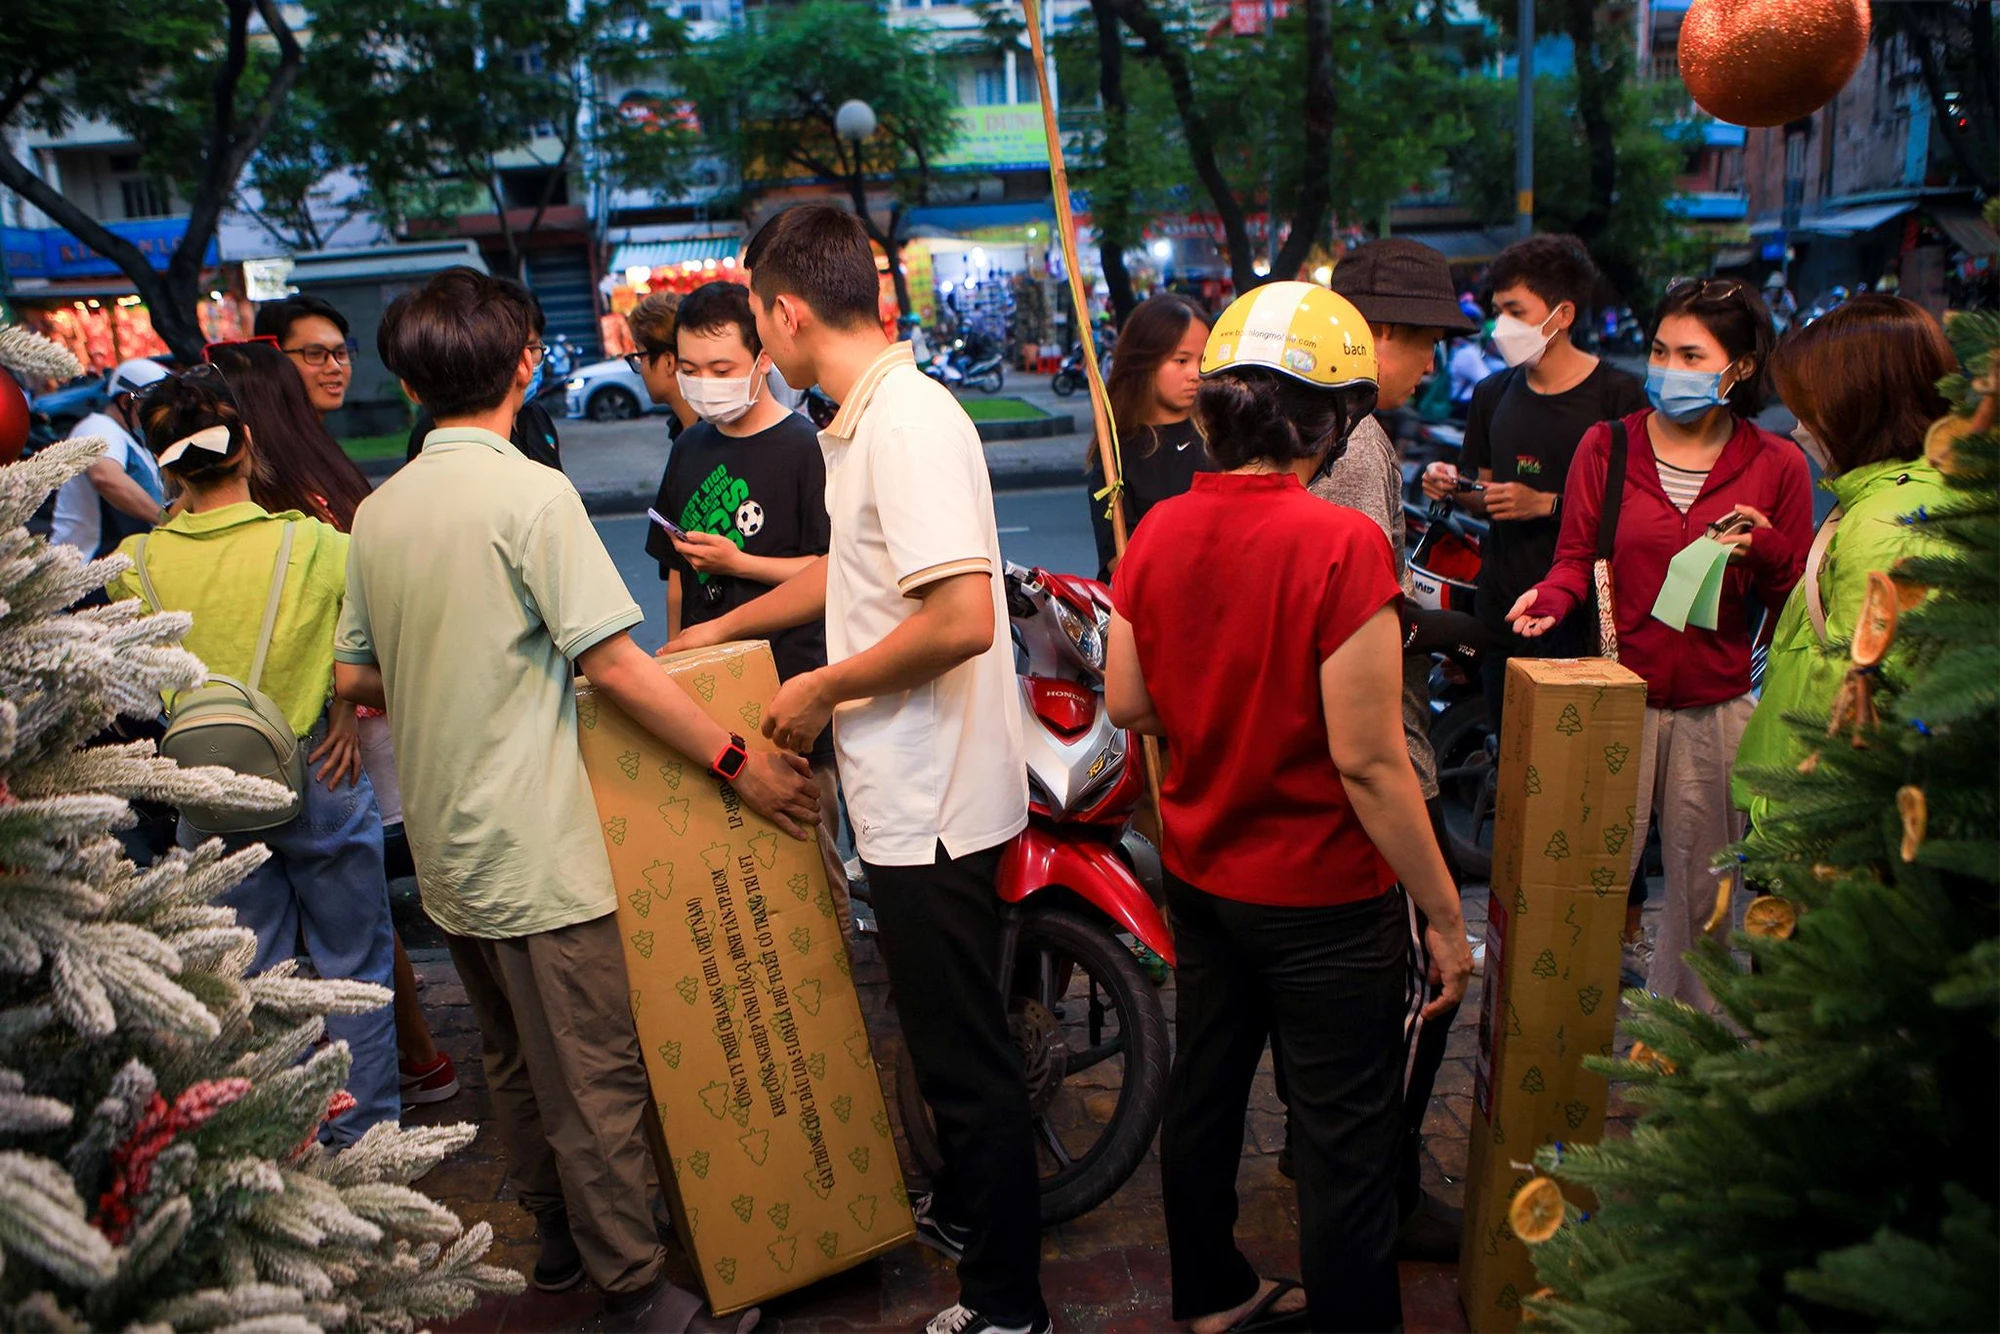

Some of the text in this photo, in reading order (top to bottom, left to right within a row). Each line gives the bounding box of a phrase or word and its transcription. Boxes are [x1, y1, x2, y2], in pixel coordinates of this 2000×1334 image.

[1343, 343, 1367, 356] bach
[700, 464, 728, 495] VICO
[700, 475, 734, 513] SCHOOL
[1046, 690, 1087, 704] HONDA
[737, 854, 754, 869] FT
[741, 866, 755, 875] 6
[739, 874, 761, 896] TRÍ
[685, 897, 706, 928] NAM)
[748, 894, 770, 933] TRANG
[753, 931, 774, 948] CÓ
[709, 987, 733, 1032] CHAANG
[719, 1031, 741, 1064] TNHH
[787, 1048, 802, 1057] 5
[728, 1062, 745, 1079] TY
[757, 1062, 781, 1095] CÔNG
[732, 1077, 753, 1110] CÔNG
[768, 1093, 787, 1118] KHU
